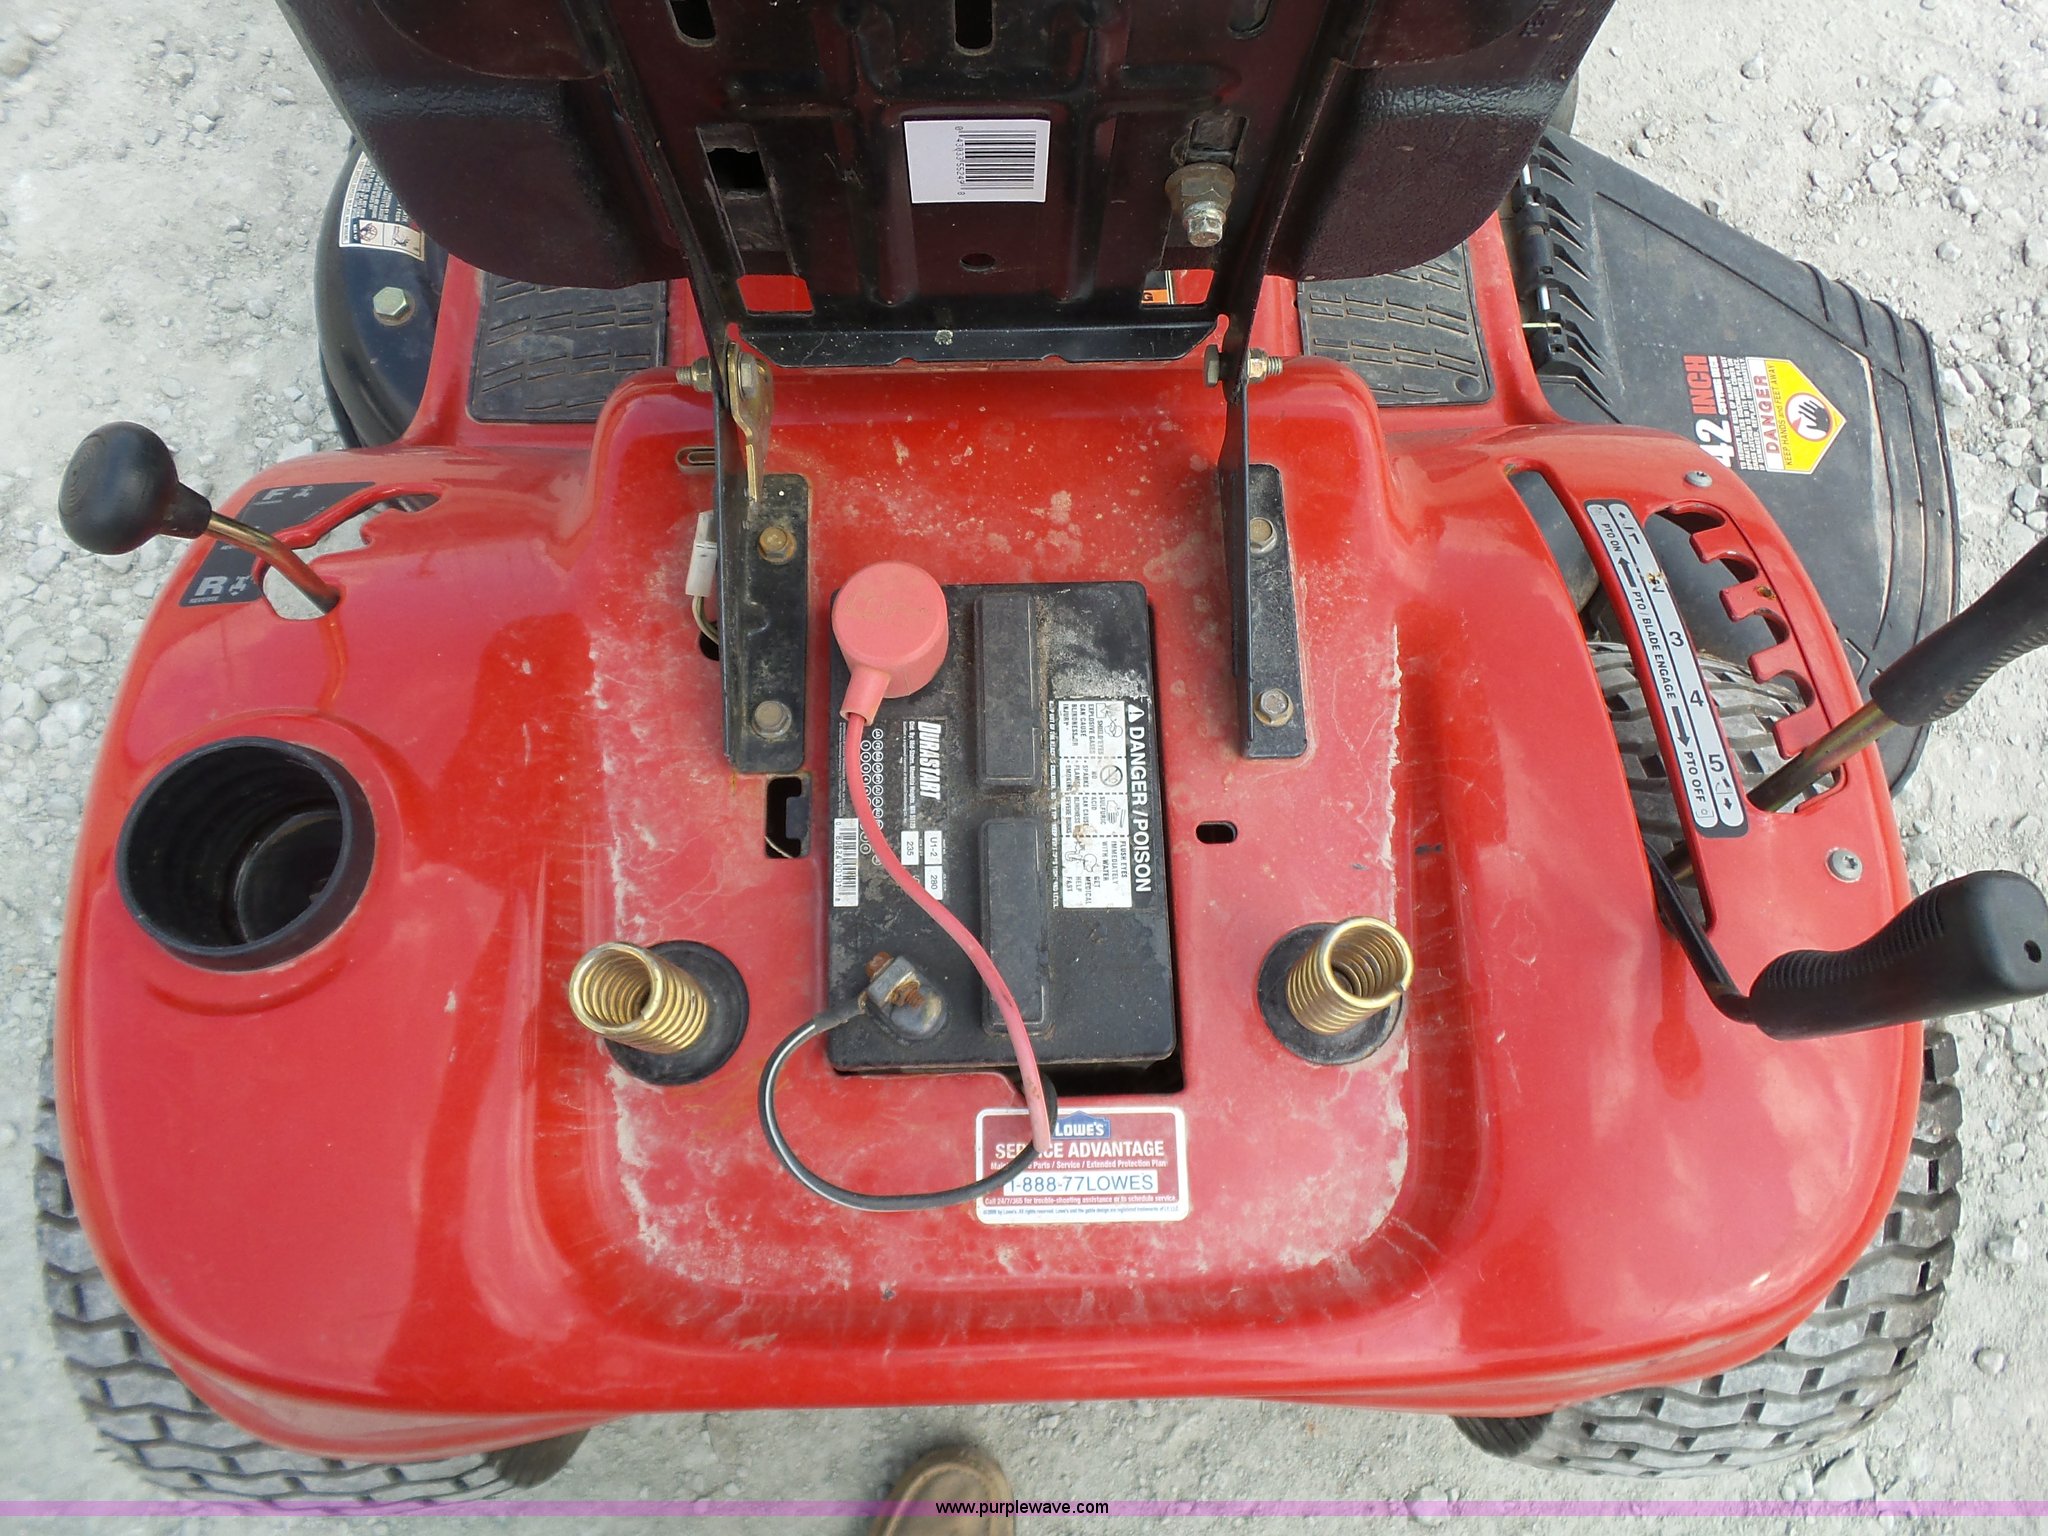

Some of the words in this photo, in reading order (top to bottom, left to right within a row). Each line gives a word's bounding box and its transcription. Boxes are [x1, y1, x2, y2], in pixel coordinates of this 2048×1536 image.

[1768, 364, 1777, 384] AWAY
[1683, 355, 1717, 414] INCH
[1772, 387, 1782, 404] FEET
[1753, 375, 1780, 454] DANGER
[1777, 405, 1785, 418] and
[1778, 420, 1789, 444] HANDS
[1695, 419, 1735, 467] 42
[1782, 446, 1792, 465] KEEP
[262, 488, 290, 500] F
[1602, 523, 1616, 538] PTO
[1609, 540, 1622, 552] ON
[194, 576, 227, 597] R
[1632, 591, 1646, 610] PTO
[1642, 618, 1660, 650] BLADE
[1653, 654, 1676, 699] ENGAGE
[1669, 632, 1684, 647] 3
[1690, 690, 1704, 707] 4
[1130, 726, 1148, 805] DANGER
[1708, 754, 1725, 772] 5
[1684, 751, 1698, 775] PTO
[1691, 779, 1706, 803] OFF
[1133, 819, 1151, 892] POISON
[1055, 1122, 1105, 1136] LOWE'S
[1068, 1141, 1164, 1158] ADVANTAGE
[1056, 1161, 1080, 1169] Service
[1087, 1160, 1116, 1168] Extended
[1011, 1175, 1153, 1192] 1-888-77LOWES
[1034, 1196, 1081, 1204] trouble-shooting
